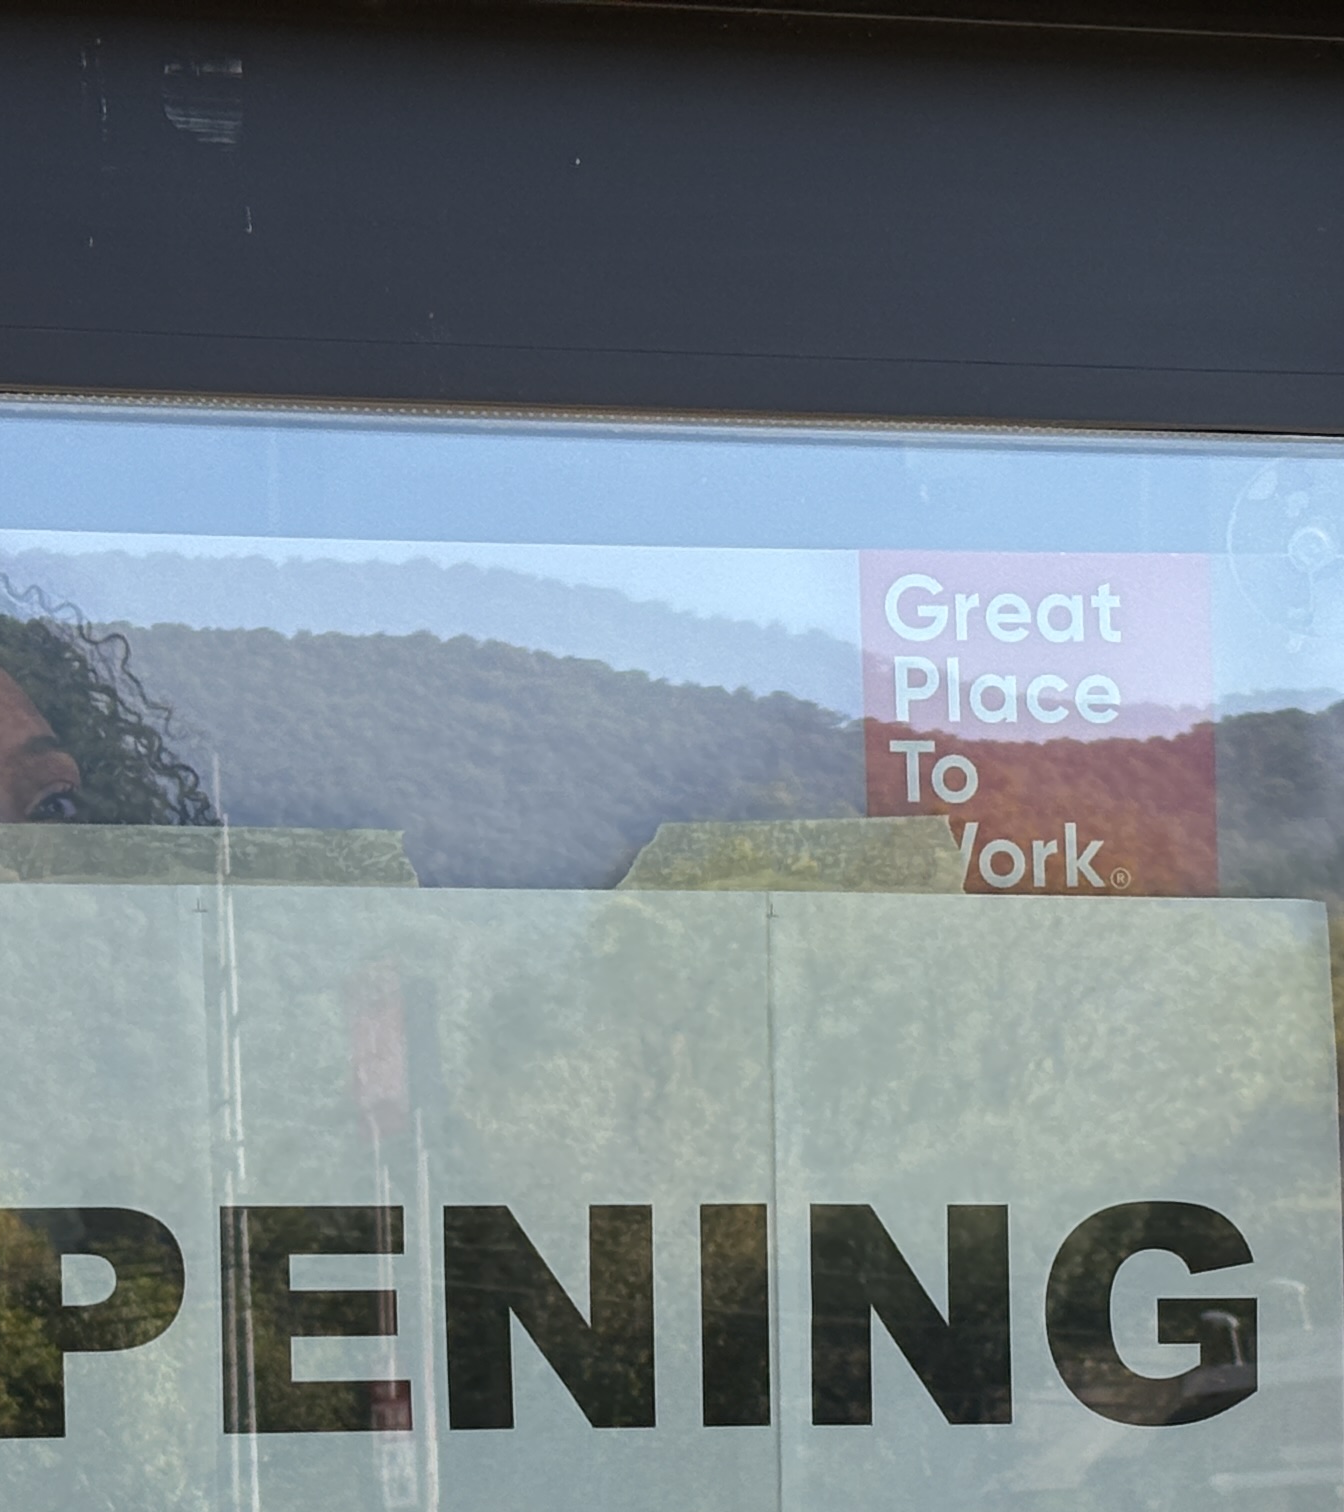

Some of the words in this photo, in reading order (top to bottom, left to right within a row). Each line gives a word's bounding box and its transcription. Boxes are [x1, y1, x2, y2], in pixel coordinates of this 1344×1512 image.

[884, 573, 1122, 643] Great
[893, 656, 1122, 724] Place
[889, 740, 979, 804] To
